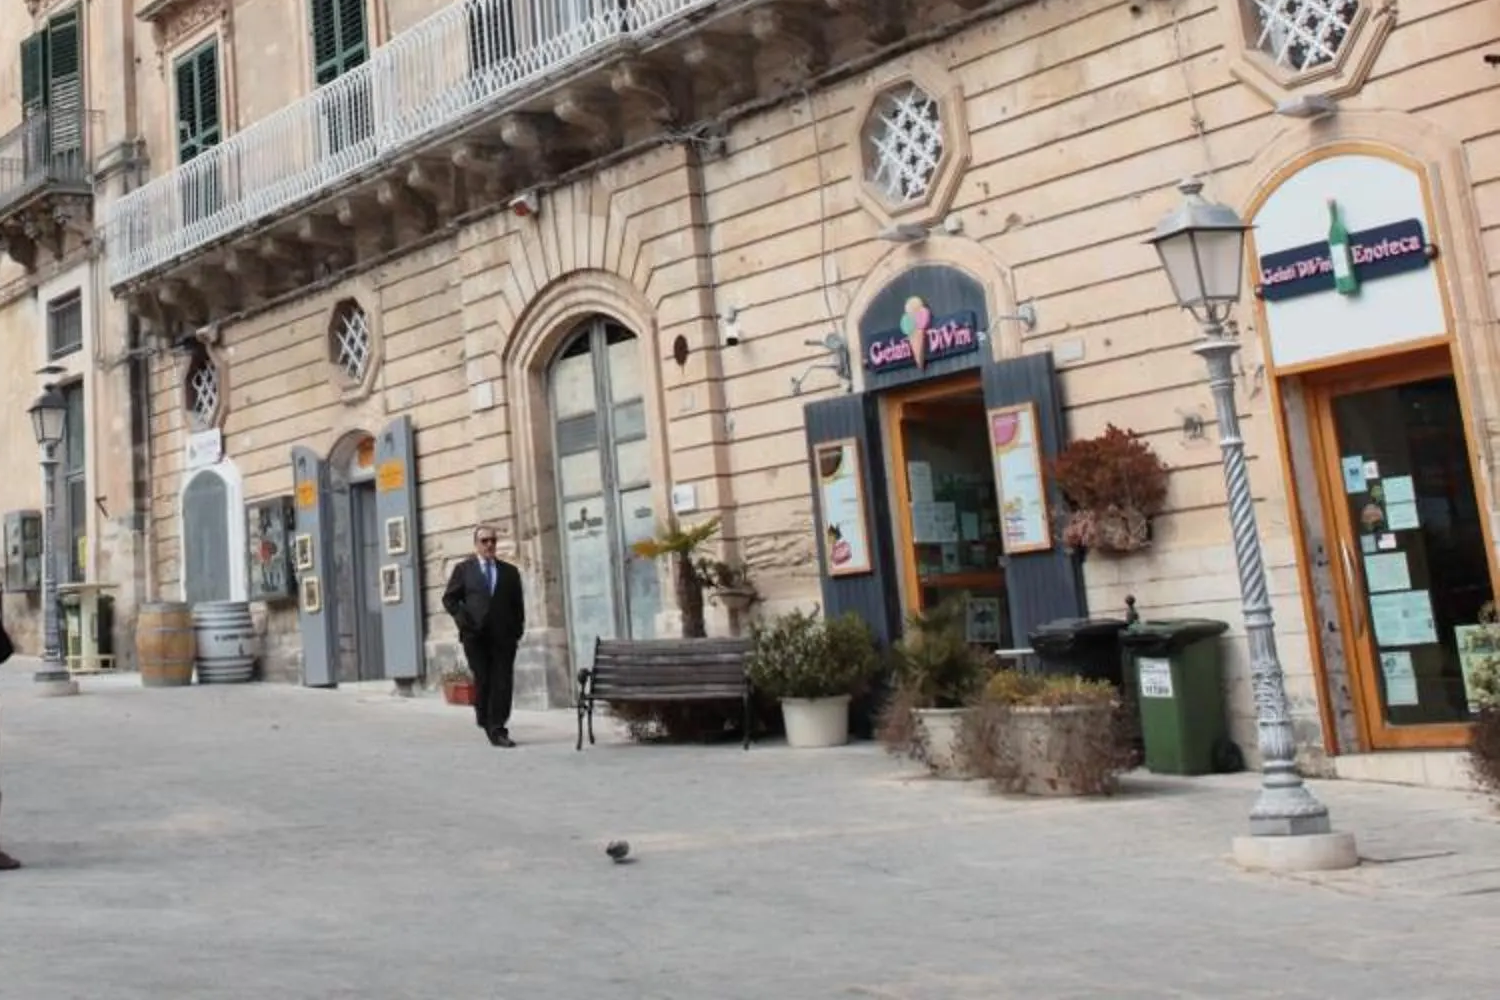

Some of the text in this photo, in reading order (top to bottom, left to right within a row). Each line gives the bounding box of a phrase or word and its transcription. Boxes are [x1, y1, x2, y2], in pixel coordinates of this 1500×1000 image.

[1351, 235, 1421, 264] Enoteca
[869, 319, 972, 365] Gelati DiVini
